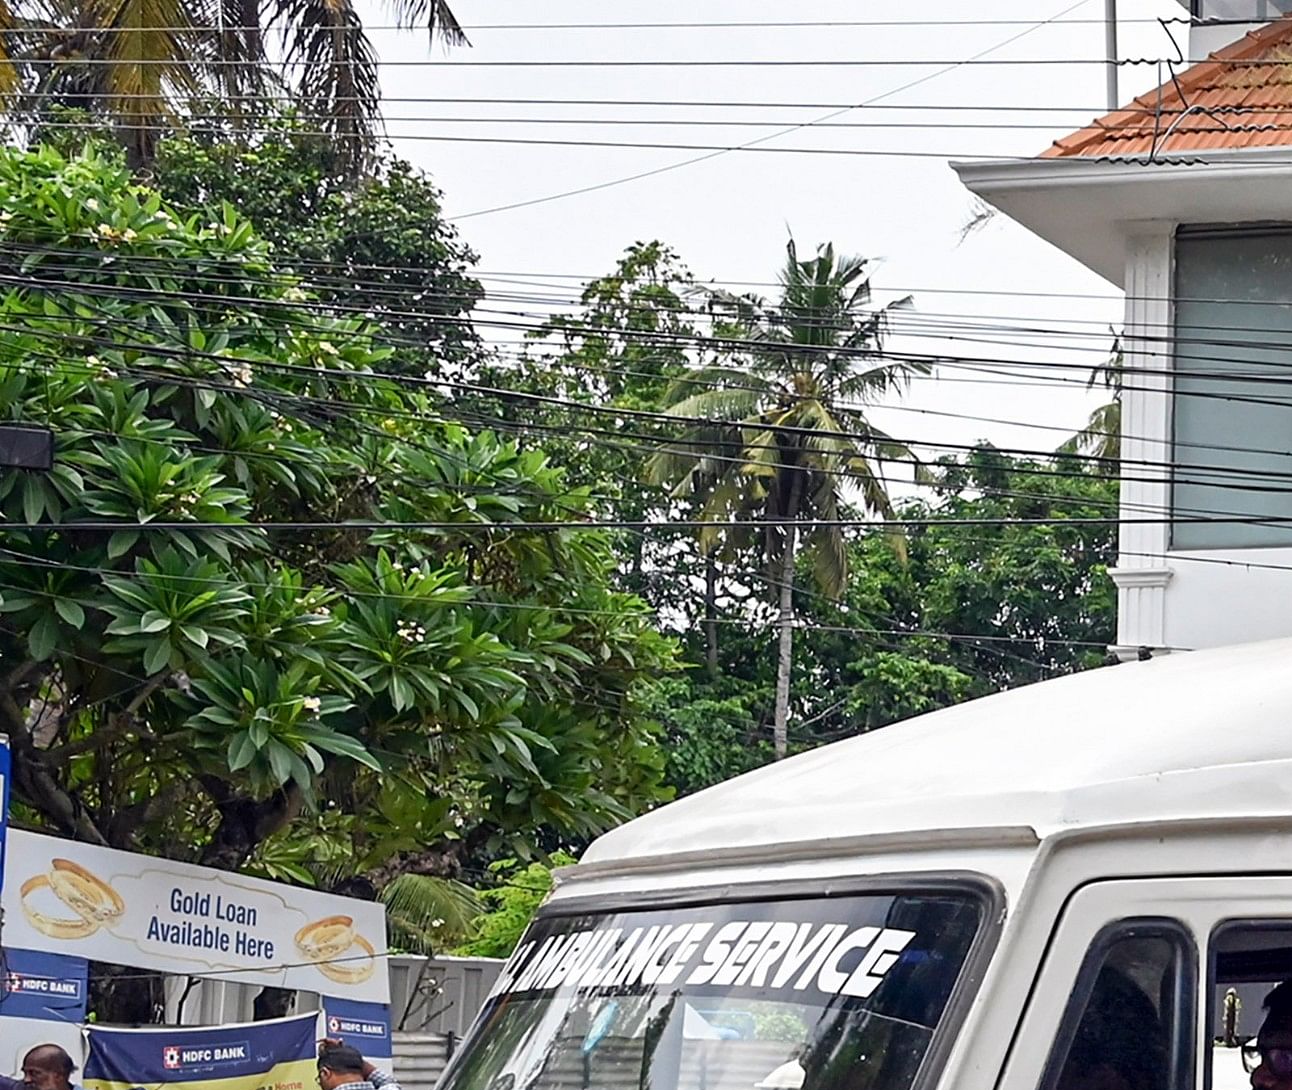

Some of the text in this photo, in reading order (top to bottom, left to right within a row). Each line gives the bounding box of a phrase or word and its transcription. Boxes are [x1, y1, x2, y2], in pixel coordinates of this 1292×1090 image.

[169, 887, 257, 927] Gold Loan
[146, 917, 274, 960] Available Here
[508, 922, 714, 994] AMBULANCE
[685, 921, 917, 999] SERVICE
[22, 978, 77, 995] HDFC BANK
[340, 1022, 384, 1035] HDFC BANK
[182, 1046, 246, 1063] HDFC BANK
